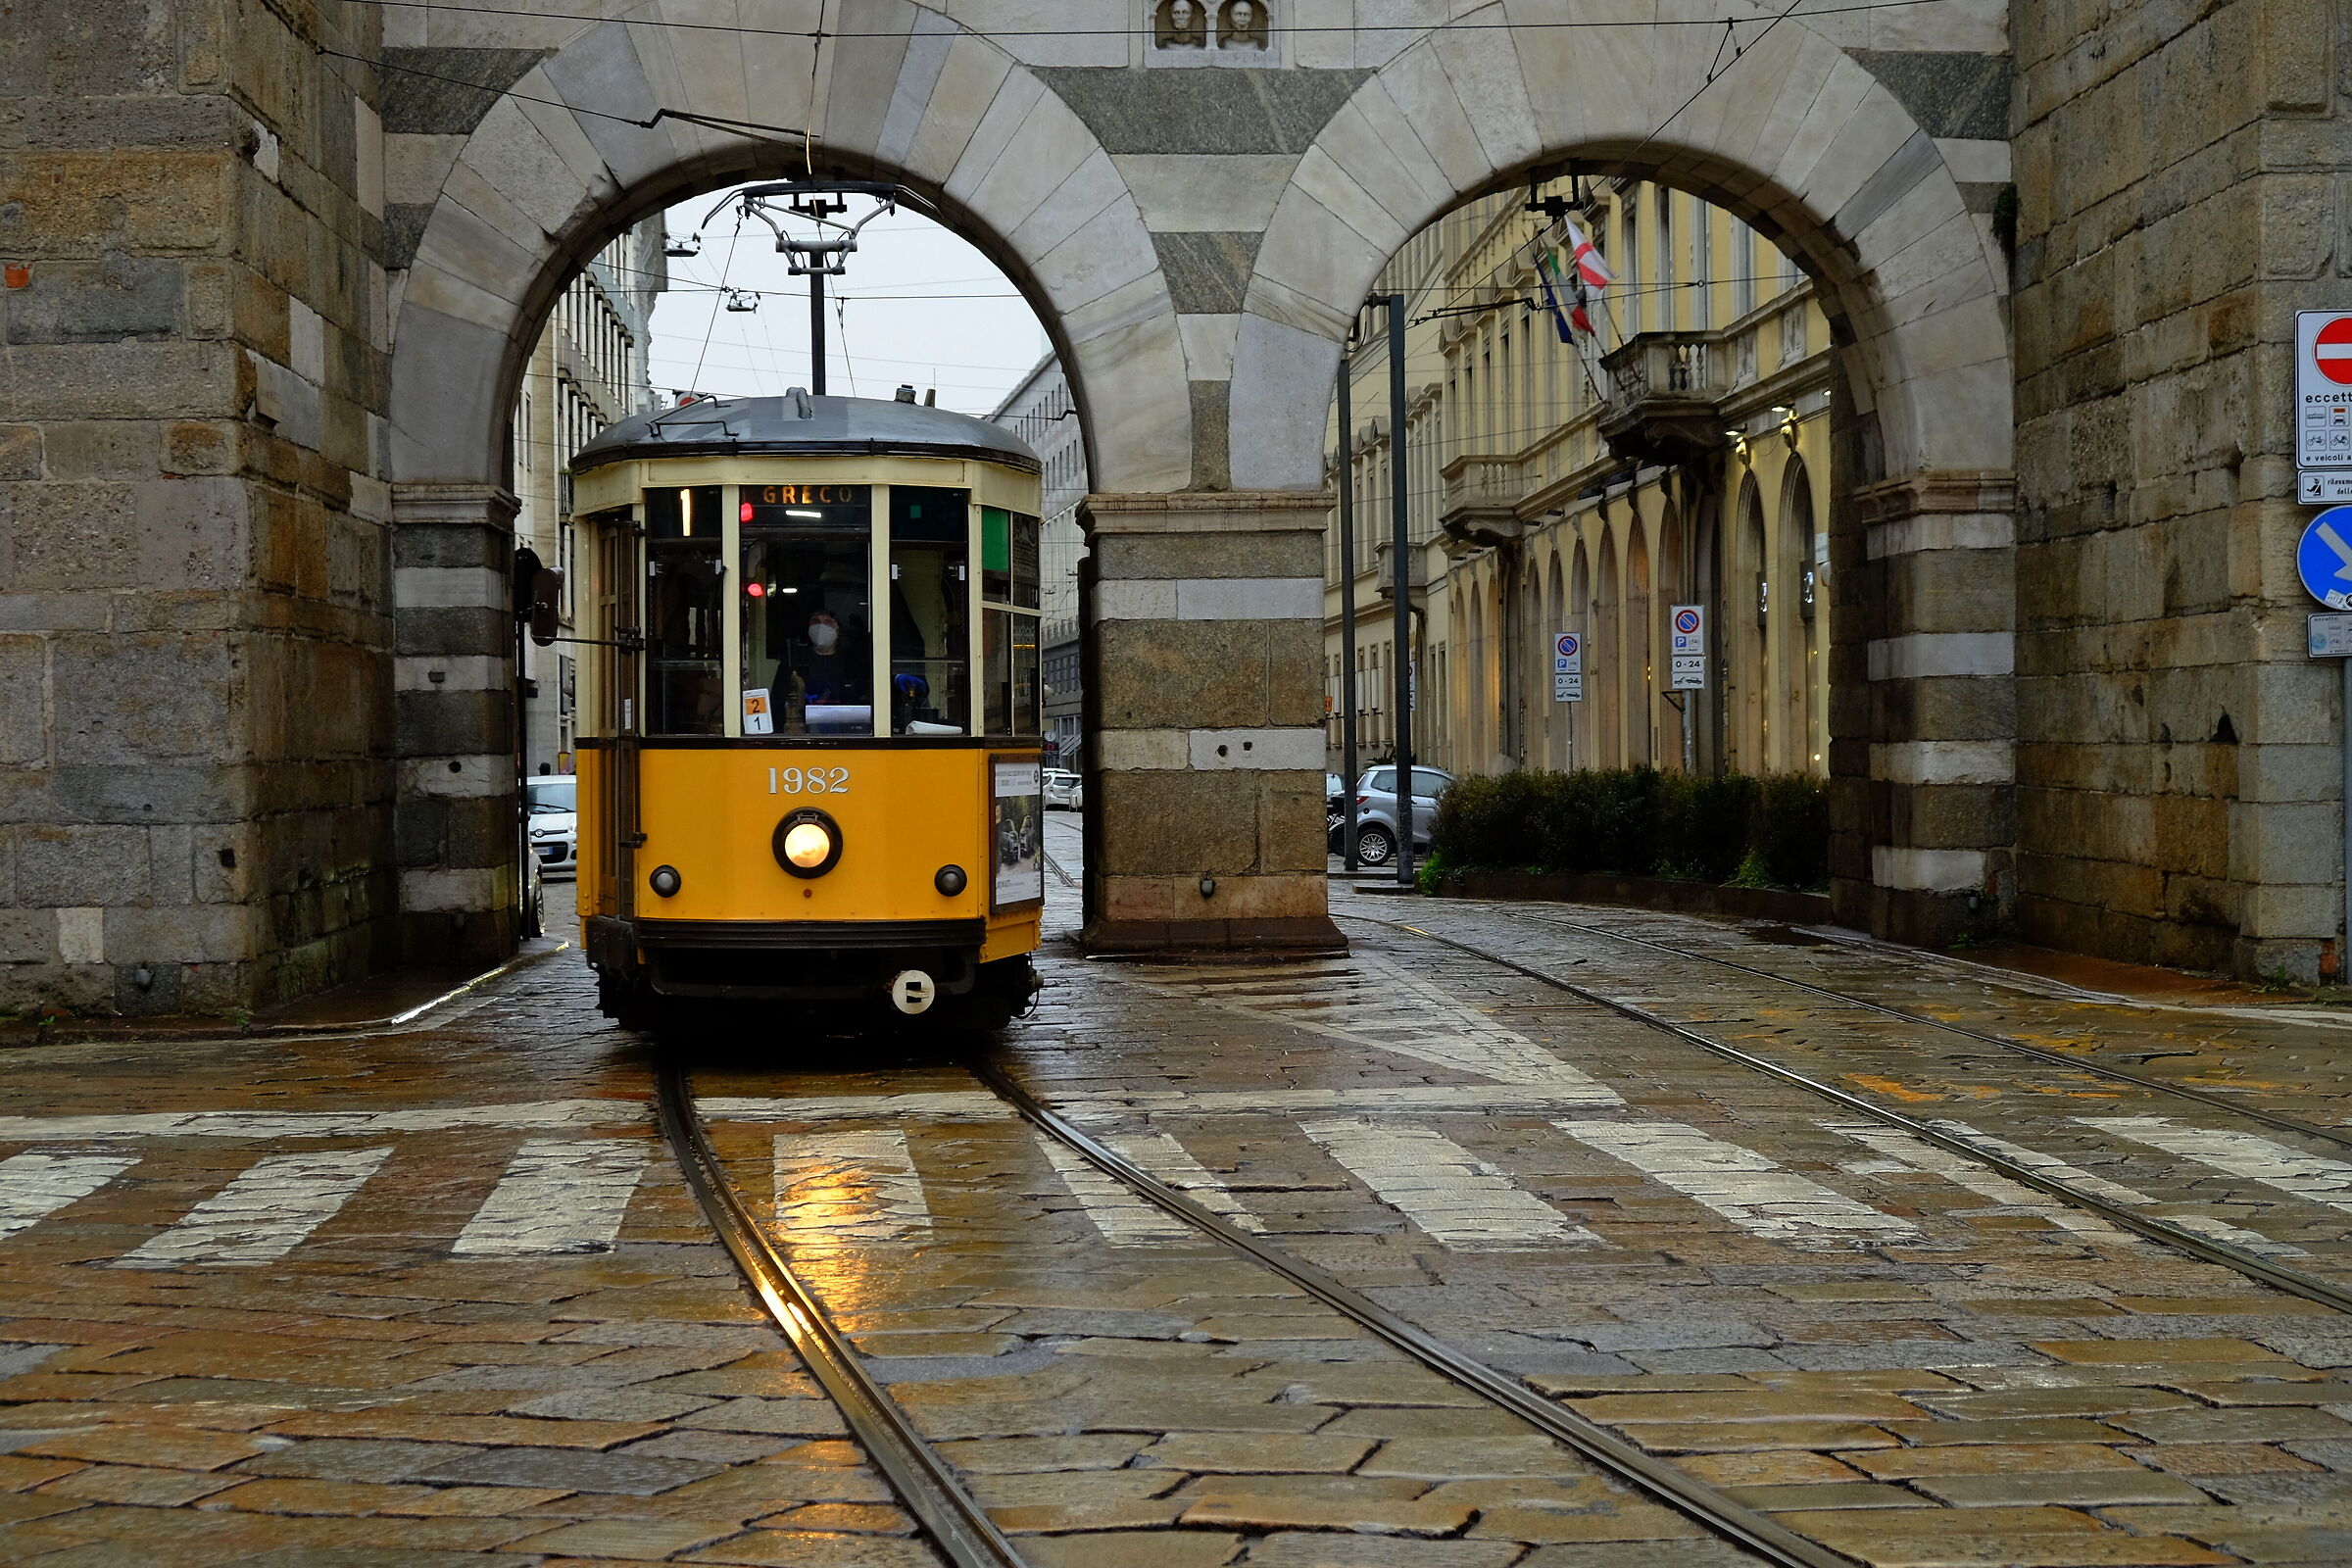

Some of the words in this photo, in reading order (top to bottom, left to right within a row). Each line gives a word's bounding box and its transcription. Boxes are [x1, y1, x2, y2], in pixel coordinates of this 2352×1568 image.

[763, 486, 852, 504] GRECO
[1677, 638, 1685, 647] P
[752, 699, 760, 713] 2
[754, 715, 760, 731] 1
[767, 767, 849, 794] 1982
